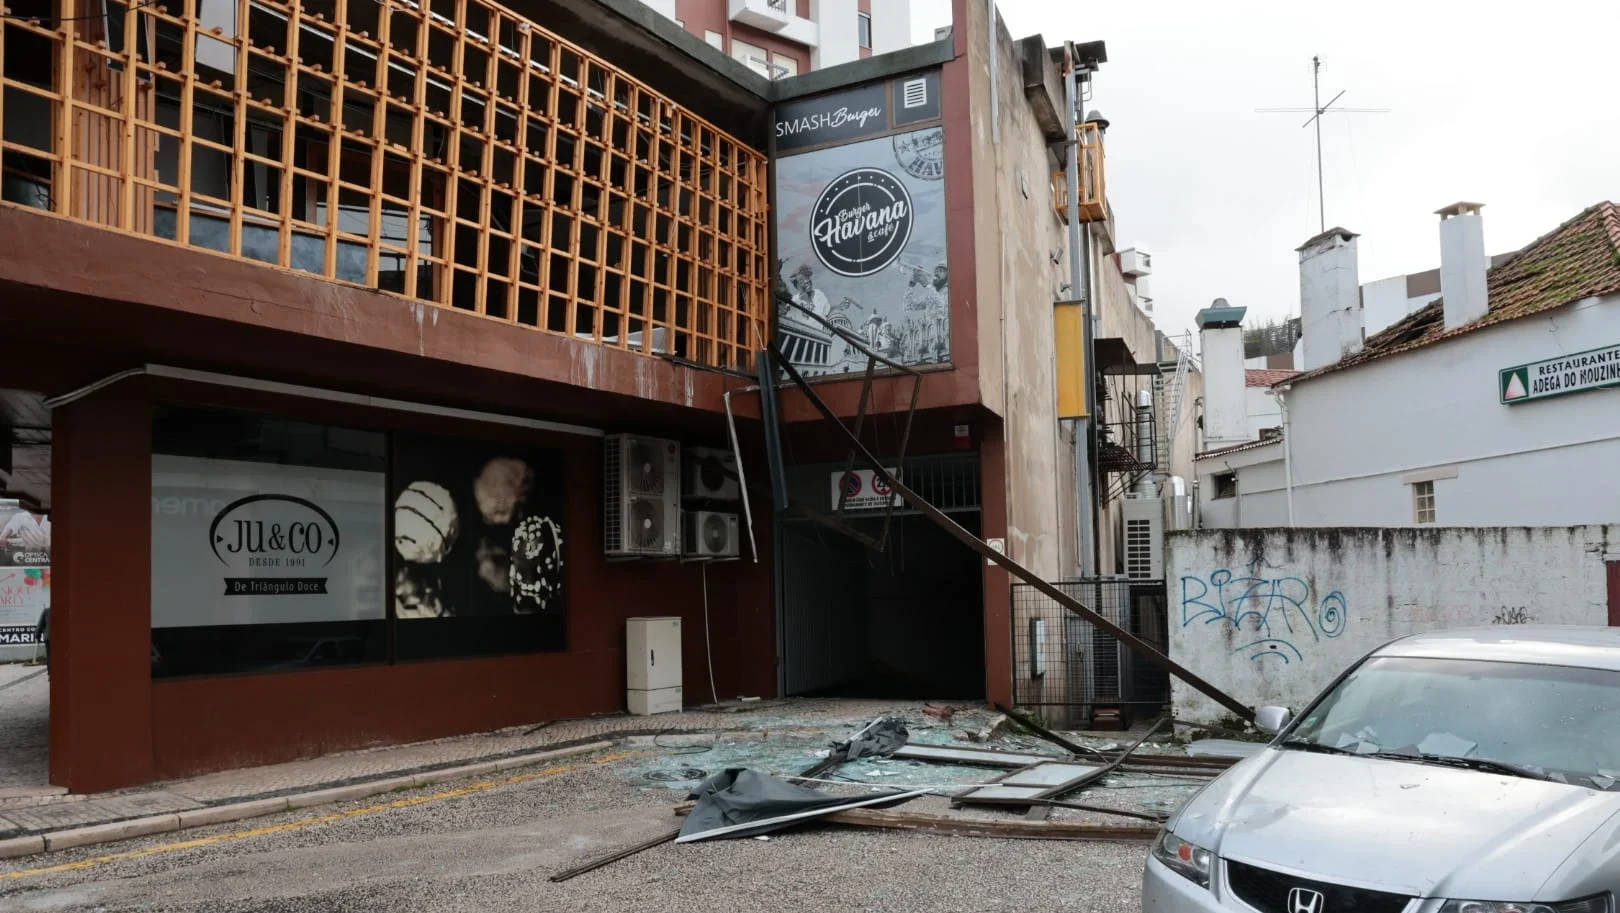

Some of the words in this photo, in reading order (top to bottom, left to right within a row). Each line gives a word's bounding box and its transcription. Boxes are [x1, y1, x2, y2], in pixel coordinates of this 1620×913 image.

[839, 202, 872, 222] Burger
[814, 200, 908, 248] Havana
[1539, 349, 1620, 376] RESTAURANTE
[1532, 375, 1561, 395] ADEGA
[1564, 372, 1577, 388] DO
[227, 519, 322, 554] JU&CO
[249, 557, 281, 567] DESDE
[285, 557, 305, 567] 1991
[234, 581, 246, 592] De
[297, 581, 319, 591] Doce
